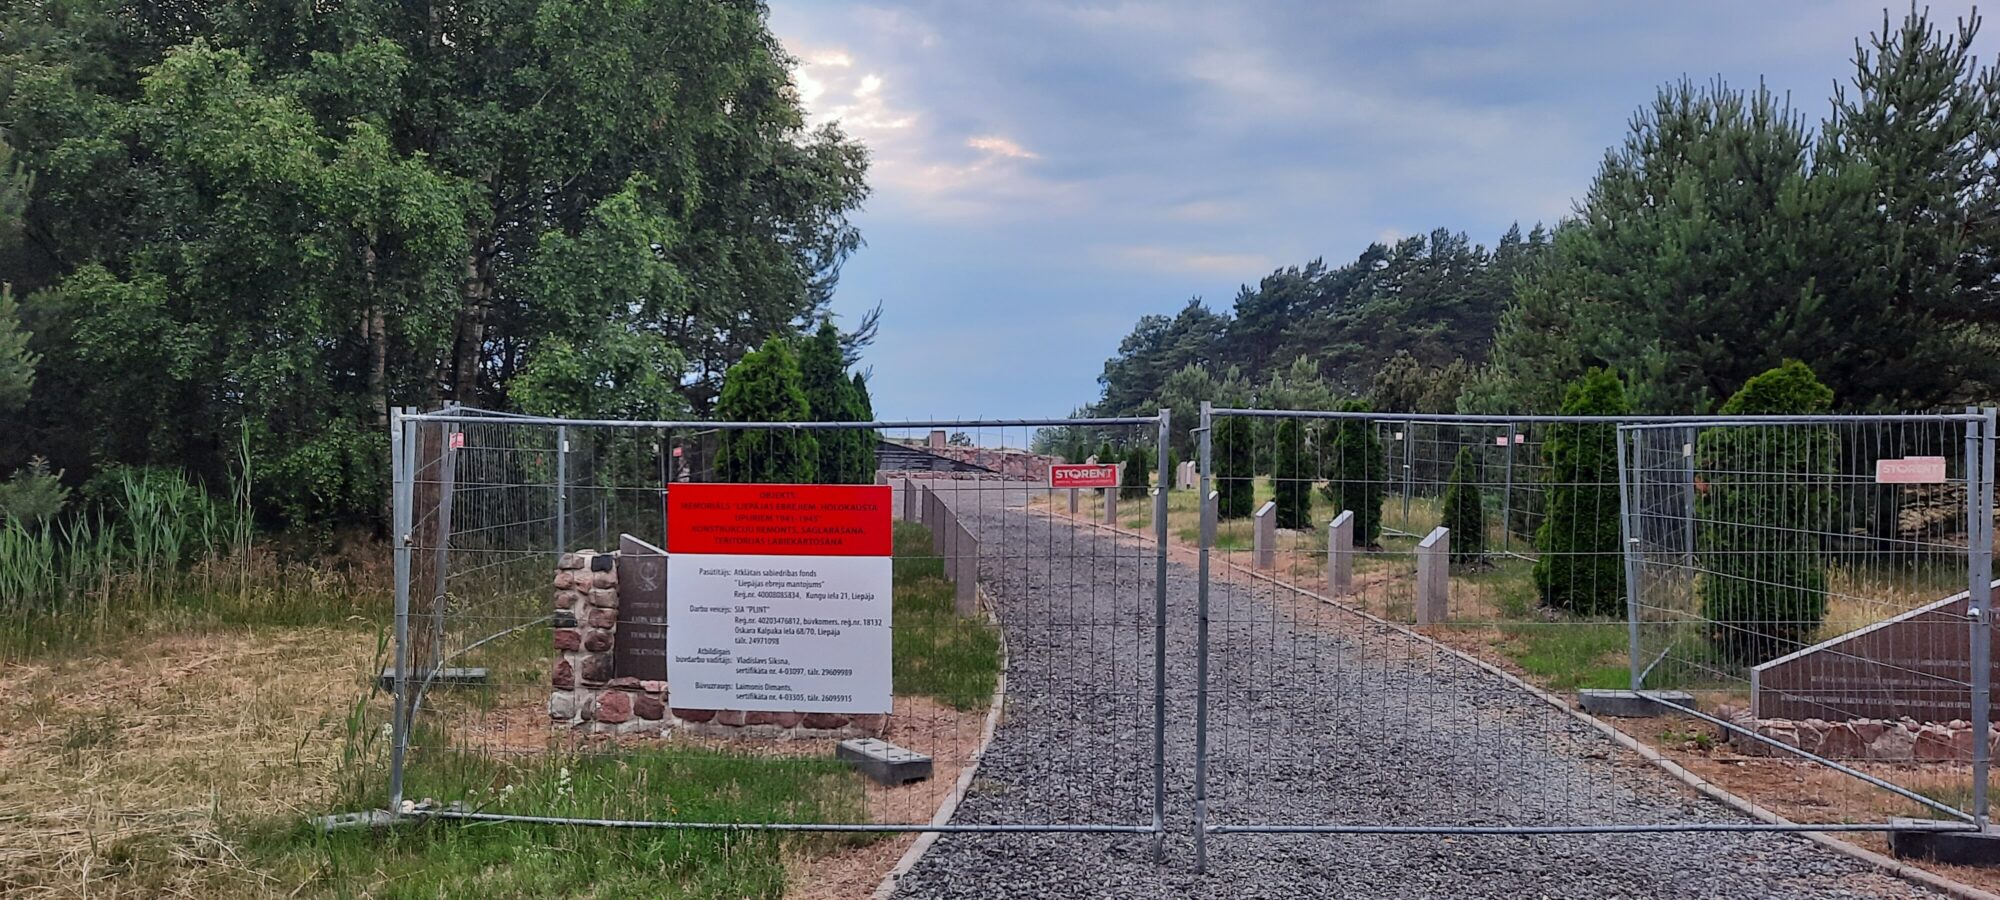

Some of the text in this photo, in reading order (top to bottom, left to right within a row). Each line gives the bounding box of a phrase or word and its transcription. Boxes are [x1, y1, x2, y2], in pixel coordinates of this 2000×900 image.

[1055, 468, 1113, 479] STORENT
[820, 503, 879, 511] HOLOKAUSTA
[734, 513, 773, 521] UPURIEM
[691, 524, 754, 533] KONSTRUKCIJU
[756, 525, 798, 534] REMONTS,
[714, 535, 765, 544] TERITORIJAS
[799, 569, 817, 577] fonds
[764, 580, 785, 589] ebreju
[786, 580, 825, 589] mantojums"
[806, 592, 826, 601] Kungu
[827, 592, 839, 600] iela
[840, 592, 850, 600] 21,
[851, 592, 875, 602] Liepāja
[689, 604, 708, 612] Darbu
[863, 618, 882, 627] 18132
[734, 626, 756, 634] Oskara
[757, 626, 782, 636] Kalpaka
[783, 627, 795, 635] iela
[817, 628, 841, 638] Liepāja
[736, 656, 767, 664] Vladislavs
[735, 682, 764, 691] Laimonis
[821, 693, 853, 702] 26095915
